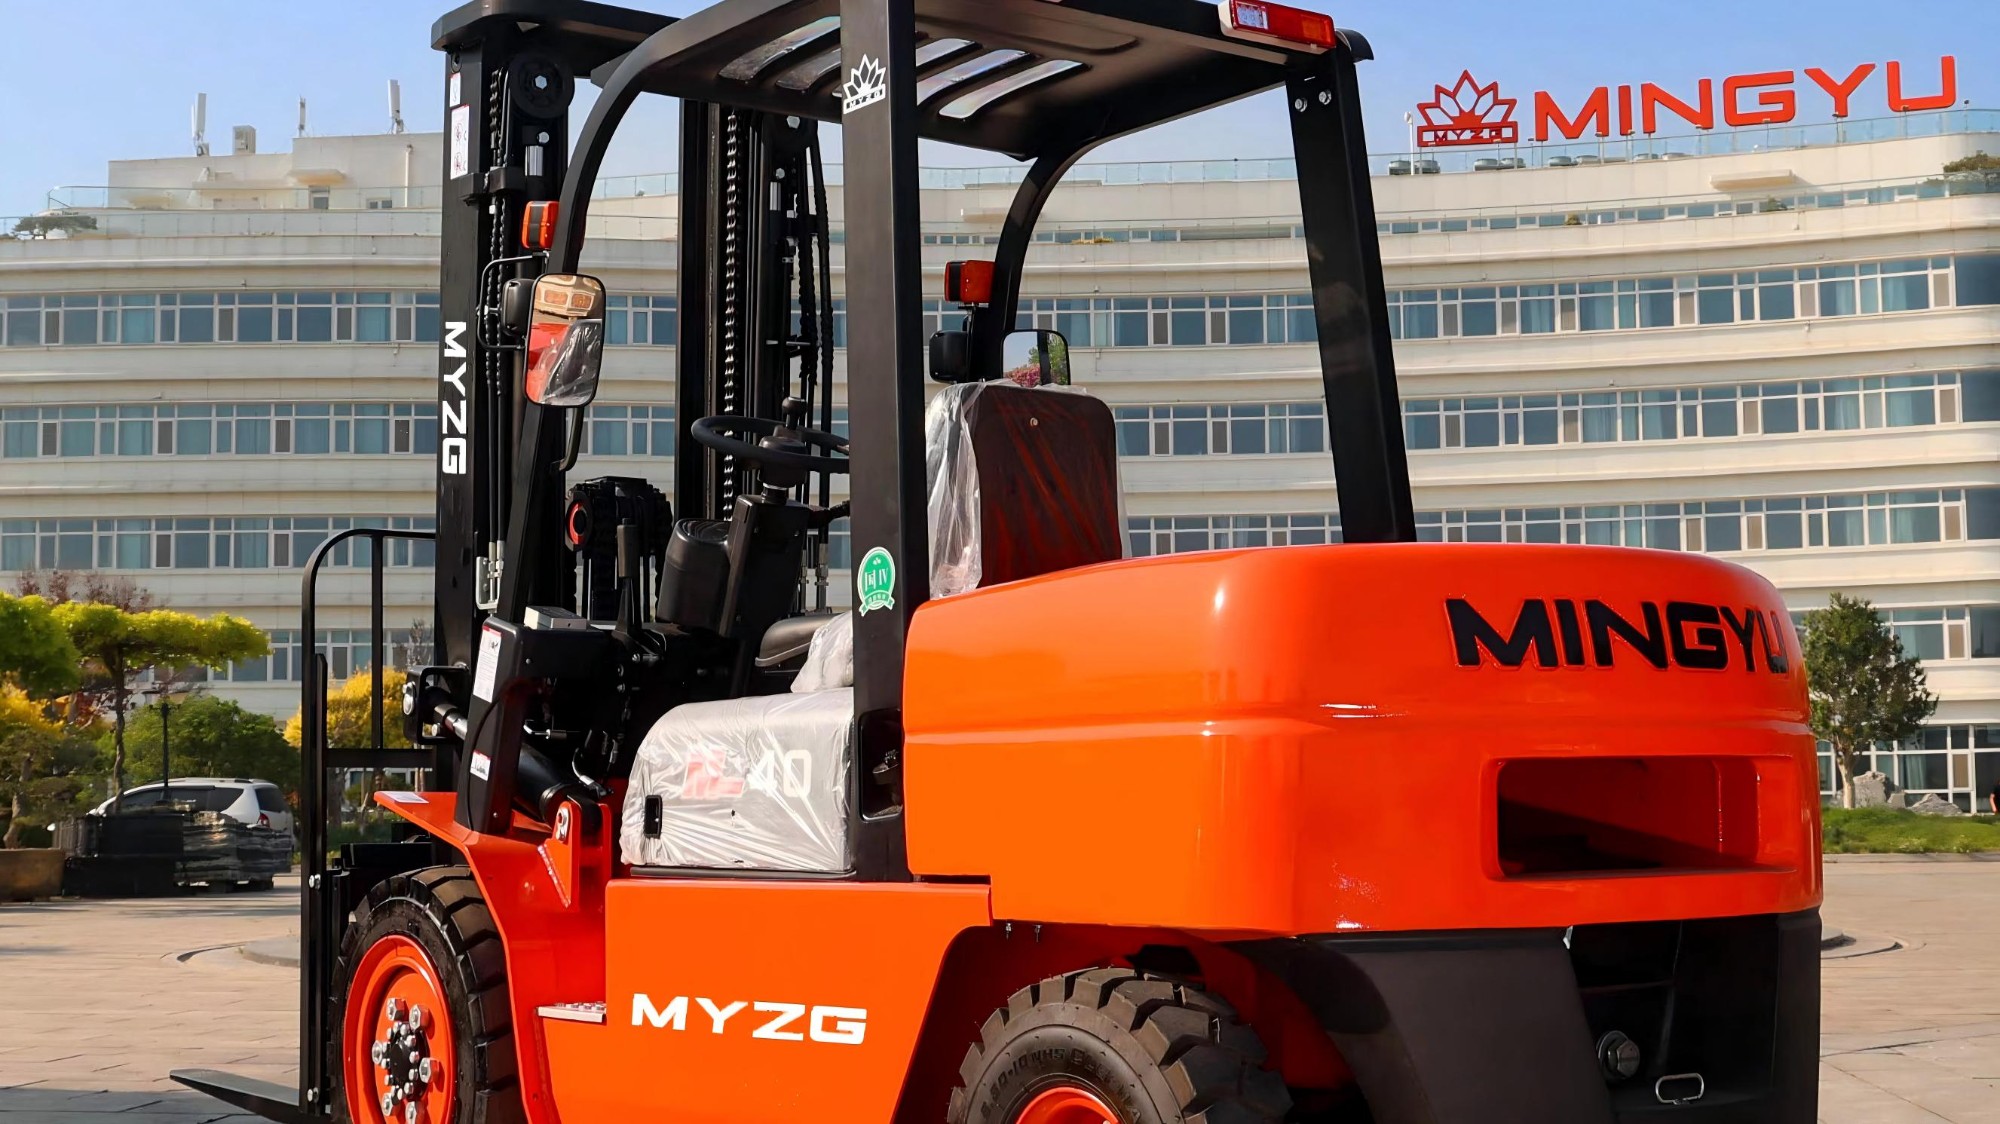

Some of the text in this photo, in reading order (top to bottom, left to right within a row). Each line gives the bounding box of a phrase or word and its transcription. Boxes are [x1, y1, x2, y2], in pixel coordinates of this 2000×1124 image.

[1534, 55, 1956, 141] MINGYU
[442, 321, 467, 475] MYZG
[1445, 598, 1789, 674] MINGYU
[631, 993, 867, 1045] MYZG
